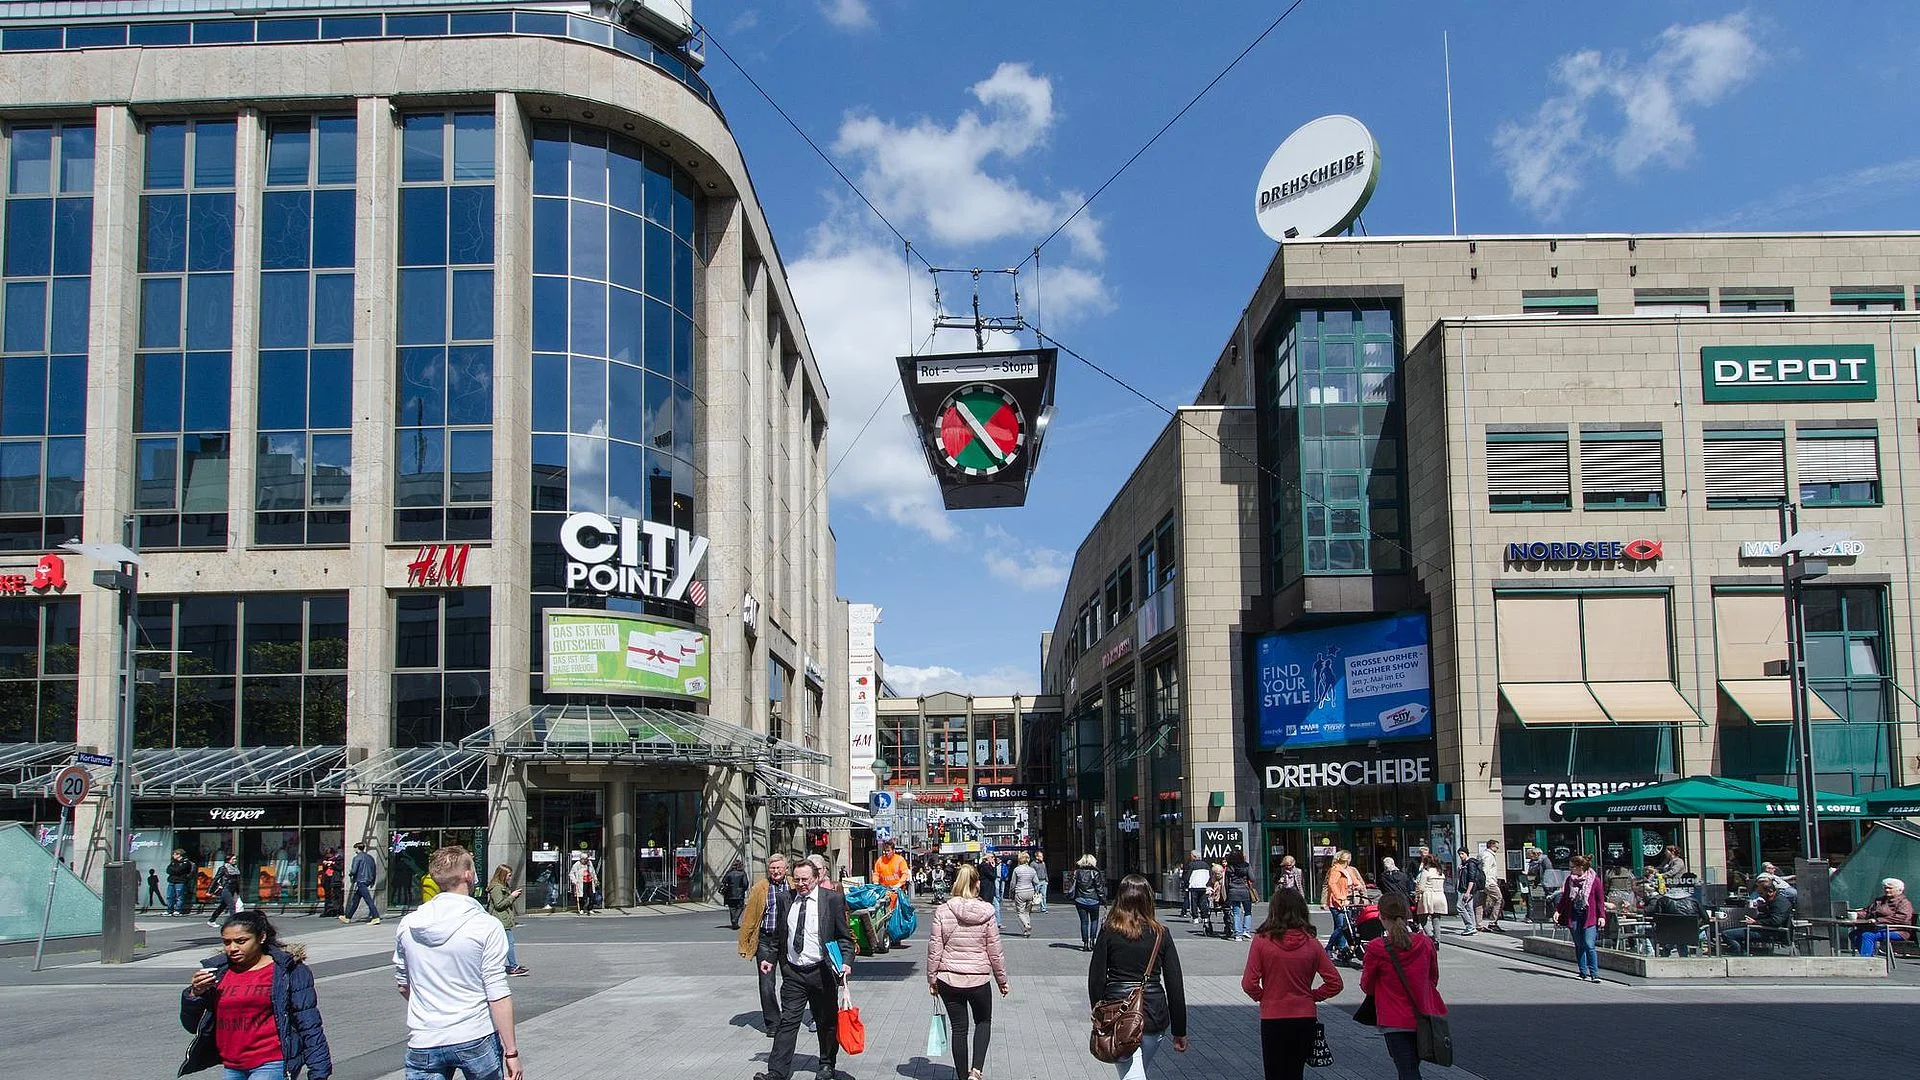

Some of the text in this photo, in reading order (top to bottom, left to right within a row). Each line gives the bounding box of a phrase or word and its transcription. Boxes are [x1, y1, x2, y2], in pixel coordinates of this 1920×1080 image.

[1261, 150, 1365, 206] DREHSCHEIBE
[921, 365, 940, 377] Rot
[1002, 359, 1034, 375] Stopp
[1713, 358, 1867, 383] DEPOT
[560, 512, 711, 600] CITY
[1510, 540, 1622, 561] NORDSEE
[407, 543, 471, 586] H&M
[567, 561, 668, 597] POINT
[553, 624, 616, 638] DAS IST KEIN
[553, 639, 606, 652] GUTSCHEIN
[1350, 657, 1381, 668] GROSSE
[1383, 651, 1418, 662] VORHER
[1263, 664, 1300, 680] FIND
[1351, 660, 1419, 677] NACHHER SHOW
[1395, 671, 1406, 680] EG
[1263, 677, 1306, 693] YOUR
[1264, 690, 1310, 707] STYLE
[1265, 757, 1431, 789] DREHSCHEIBE
[64, 777, 83, 796] 20
[989, 788, 1028, 798] mStore
[1528, 782, 1659, 799] STARBU
[209, 807, 266, 822] Pieper
[1765, 804, 1861, 813] STARBS COFFEE
[1206, 830, 1239, 841] Wo ist
